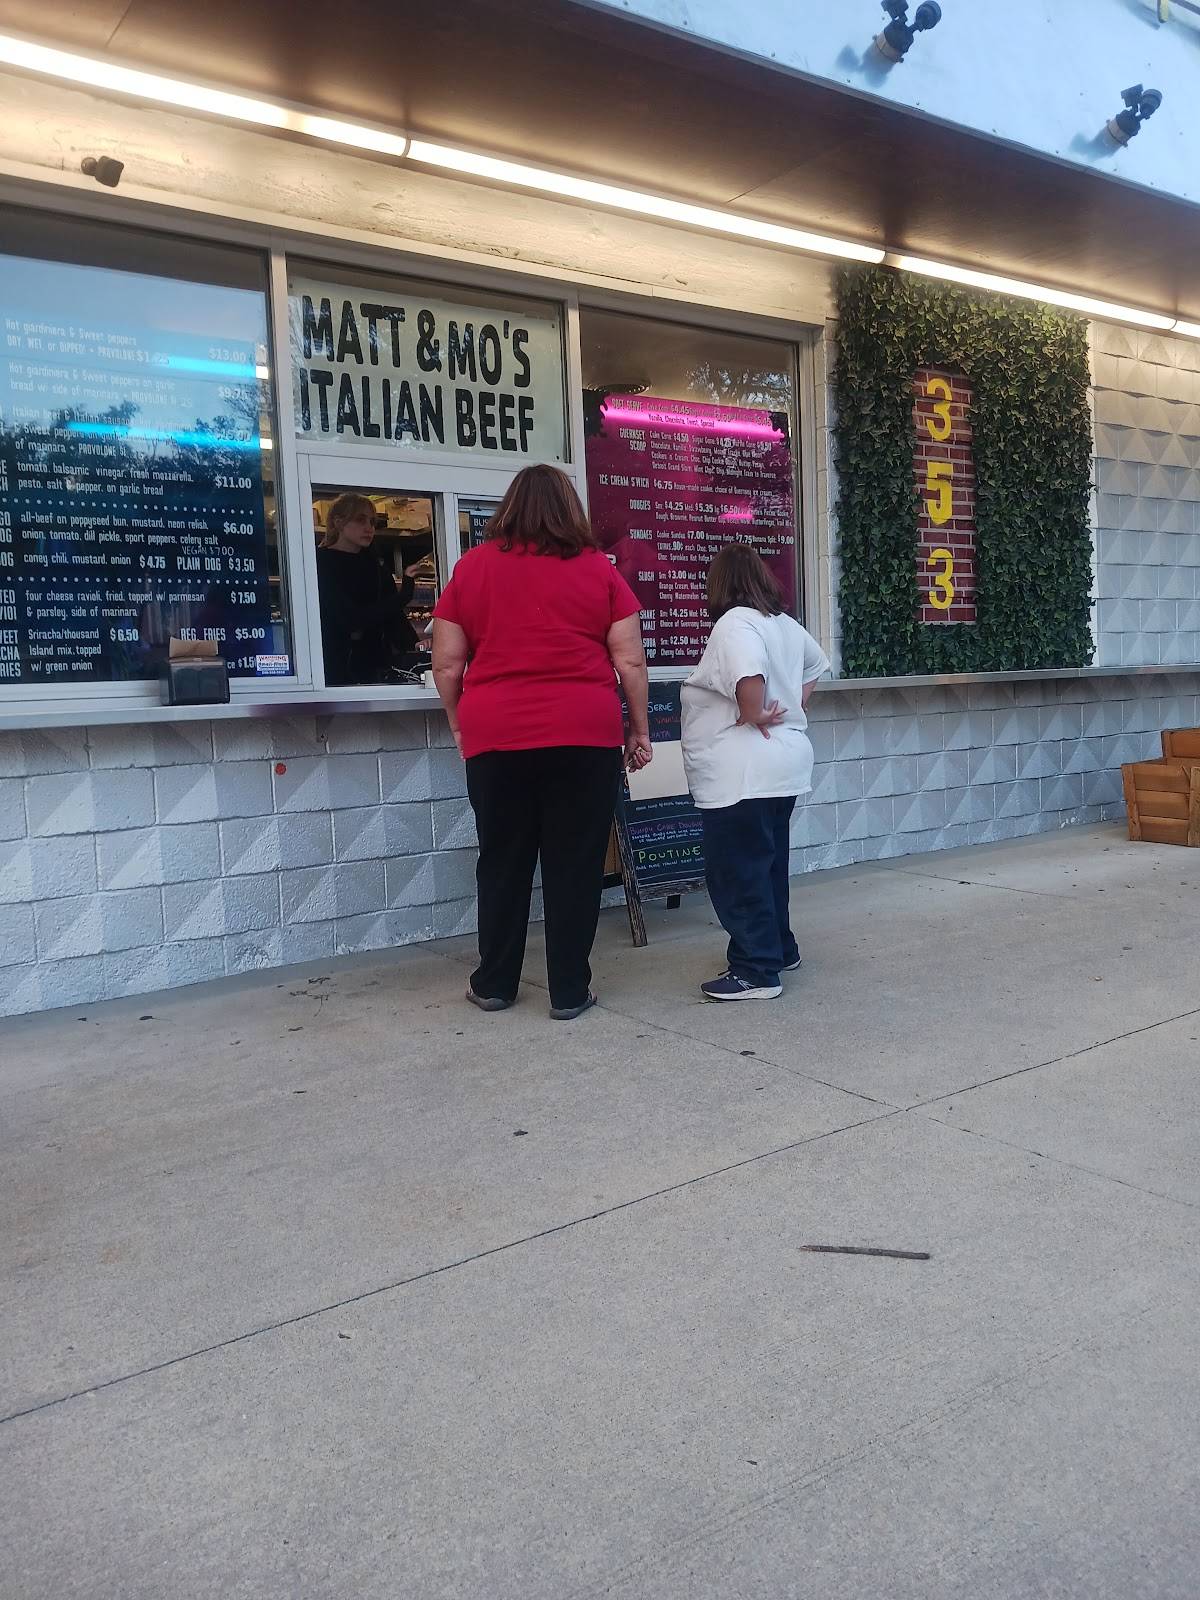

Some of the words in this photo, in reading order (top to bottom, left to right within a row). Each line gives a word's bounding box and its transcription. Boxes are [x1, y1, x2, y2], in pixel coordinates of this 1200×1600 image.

[303, 295, 405, 367] MATT
[417, 309, 442, 372] &
[448, 319, 531, 388] MO'S
[299, 368, 445, 444] ITALIAN
[455, 388, 534, 452] BEEF
[15, 438, 25, 450] of
[53, 462, 90, 477] balsamic
[130, 468, 150, 480] fresh
[47, 479, 63, 490] salt
[106, 484, 117, 493] on
[119, 482, 141, 496] garlic
[143, 484, 164, 496] bread
[215, 474, 253, 489] $11.00
[653, 478, 673, 490] $6.75
[664, 501, 684, 510] $4.25
[695, 502, 714, 513] $5.35
[20, 511, 53, 524] all-beef
[57, 515, 67, 525] on
[70, 515, 110, 529] poppyseed
[167, 520, 186, 530] neon
[223, 520, 254, 537] $6.00
[629, 528, 653, 540] SUNDAES
[687, 530, 705, 540] $7.00
[736, 532, 753, 543] $7.75
[778, 534, 795, 544] $9.00
[84, 530, 96, 541] dill
[125, 532, 145, 545] sport
[180, 534, 202, 548] celery
[204, 535, 219, 546] salt
[23, 553, 49, 567] coney
[110, 554, 131, 565] onion
[139, 554, 167, 569] $4.75
[177, 555, 201, 571] PLAIN
[204, 556, 222, 571] DOG
[228, 556, 255, 572] $3.50
[638, 570, 655, 581] SLUSH
[668, 570, 687, 579] $3.00
[25, 589, 43, 602] four
[46, 590, 74, 602] cheese
[128, 591, 153, 604] topped
[155, 591, 166, 602] w/
[168, 593, 205, 605] parmesan
[230, 591, 257, 605] $7.50
[27, 605, 34, 618] &
[70, 605, 87, 617] side
[89, 606, 99, 617] of
[101, 607, 138, 618] marinara
[640, 609, 656, 619] SHAKE
[669, 608, 689, 618] $4.25
[643, 620, 656, 630] MALT
[110, 627, 139, 642] $6.50
[203, 627, 226, 642] FRIES
[234, 627, 266, 642] $5.00
[643, 637, 657, 647] SODA
[670, 636, 689, 646] $2.50
[29, 643, 54, 656] Island
[75, 643, 102, 658] topped
[646, 648, 658, 658] POP
[31, 660, 42, 672] w/
[45, 661, 70, 675] green
[71, 659, 93, 671] onion
[638, 845, 701, 864] POUTINE
